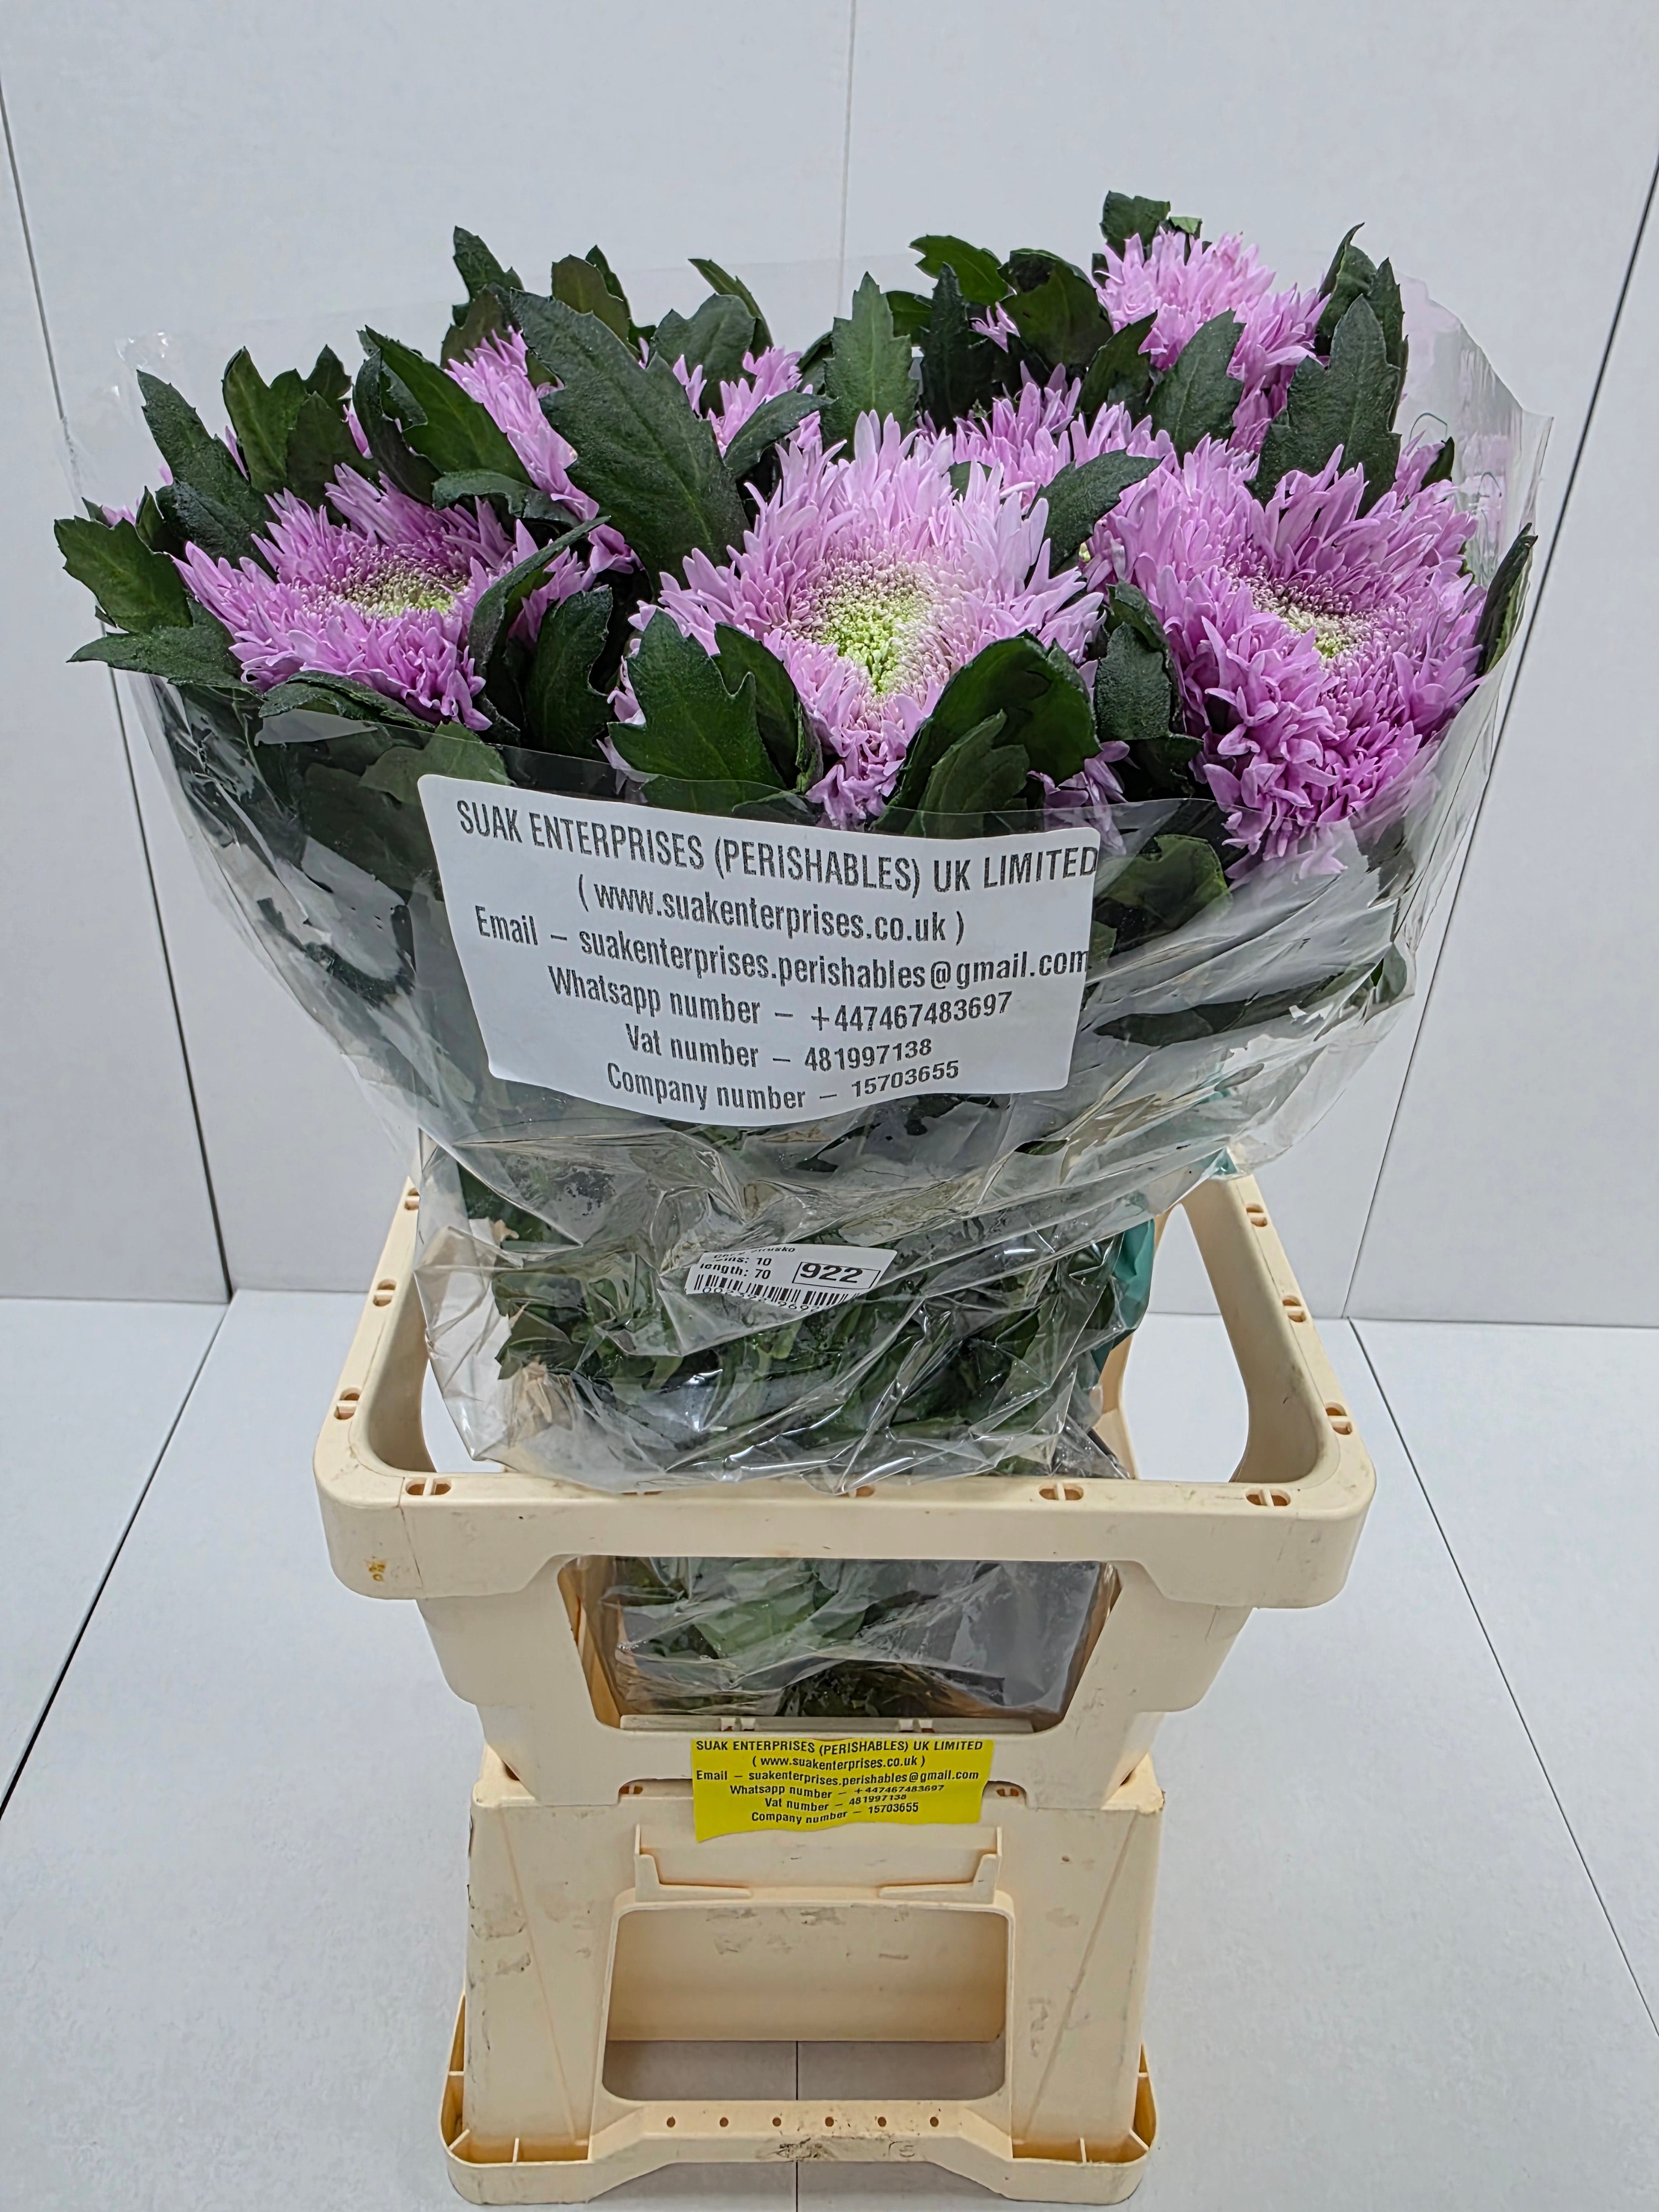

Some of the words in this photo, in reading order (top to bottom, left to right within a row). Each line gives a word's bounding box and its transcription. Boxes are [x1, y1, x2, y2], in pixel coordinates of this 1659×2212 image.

[457, 800, 523, 843] SUAK
[529, 811, 705, 870] ENTERPRISES
[714, 836, 920, 899] (PERISHABLES)
[934, 859, 971, 894] UK
[984, 846, 1099, 889] LIMITED
[593, 883, 946, 942] www.suakenterprises.co.uk
[474, 905, 539, 946] Email
[579, 930, 1088, 990] suakenterprises.perishables@gmail.com
[547, 965, 662, 1018] Whatsapp
[670, 992, 761, 1025] number
[811, 991, 1013, 1032] +447467483697
[625, 1023, 662, 1057] Vat
[670, 1038, 759, 1068] number
[805, 1038, 932, 1072] 481997138
[608, 1062, 707, 1111] Company
[717, 1086, 806, 1110] number
[851, 1060, 959, 1098] 15703655
[757, 1258, 772, 1266] 10
[800, 1262, 863, 1284] 922
[755, 1269, 771, 1280] 70
[696, 1740, 728, 1751] SUAK
[733, 1741, 815, 1753] ENTERPRISES
[819, 1740, 909, 1756] (PERISHABLES)
[914, 1741, 930, 1751] UK
[934, 1741, 983, 1750] LIMITED
[760, 1755, 917, 1771] www.suakenterprises.co.uk
[696, 1770, 728, 1780] Email
[748, 1770, 979, 1787] suakenterprises.perishables@gmail.com
[730, 1785, 785, 1795] Whatsapp
[790, 1786, 832, 1798] number
[854, 1785, 945, 1794] +447467483697
[752, 1812, 802, 1825] Company
[806, 1812, 847, 1824] number
[868, 1802, 919, 1814] 15703655
[765, 1798, 782, 1807] Vat
[786, 1800, 829, 1812] number
[849, 1794, 906, 1806] 481997138
